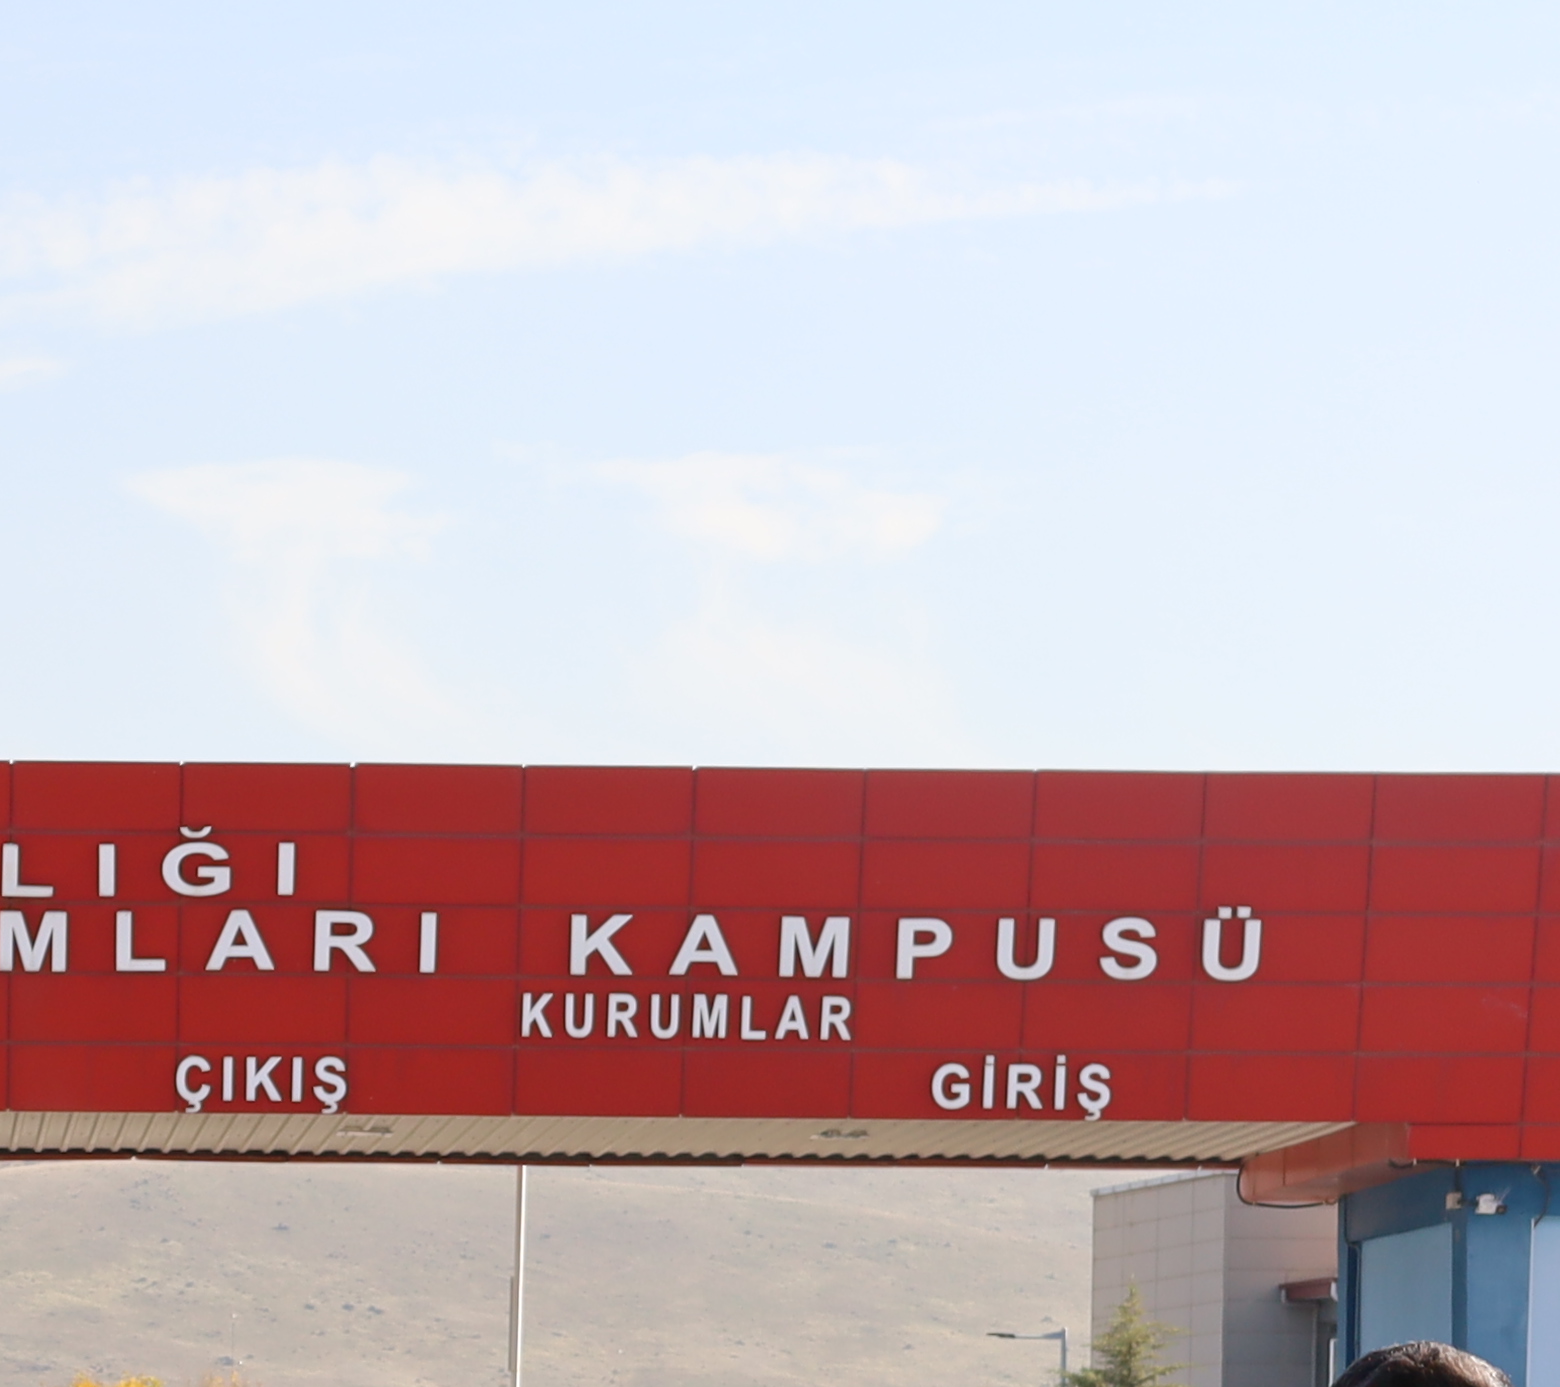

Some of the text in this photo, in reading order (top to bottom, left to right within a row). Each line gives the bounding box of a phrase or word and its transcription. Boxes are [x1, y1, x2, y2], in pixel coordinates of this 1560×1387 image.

[570, 906, 1262, 982] KAMPUSÜ
[521, 992, 851, 1041] KURUMLAR
[174, 1055, 349, 1115] ÇIKIŞ
[931, 1054, 1111, 1122] GİRİŞ
